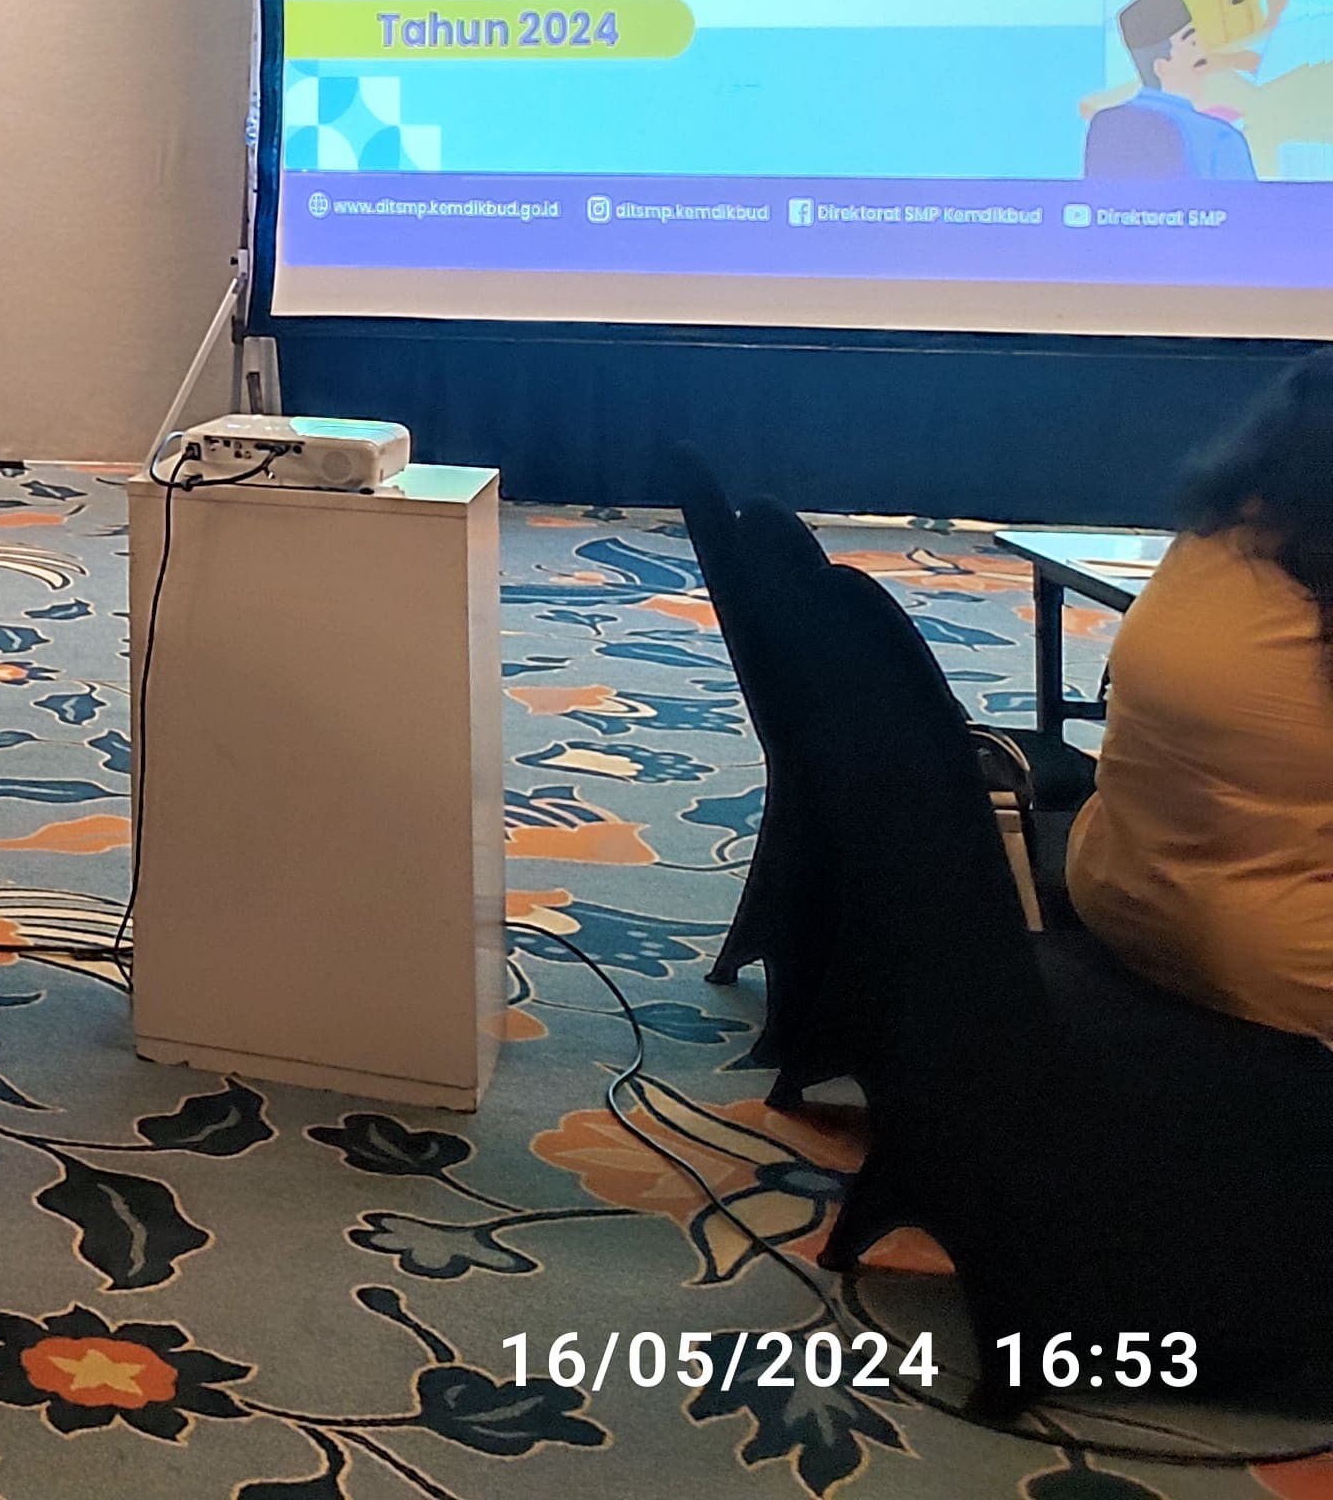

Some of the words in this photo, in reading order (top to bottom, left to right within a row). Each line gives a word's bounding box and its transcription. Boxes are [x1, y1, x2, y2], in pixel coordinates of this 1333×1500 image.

[376, 11, 510, 49] Tahun
[518, 10, 620, 48] 2024
[333, 199, 560, 223] www.ditsmp.kemdikbud.go.id
[615, 202, 771, 224] ditsmp.kemdikbud
[817, 203, 901, 222] Direktorat
[904, 206, 939, 223] SMP
[942, 206, 1043, 225] Kemdikbud
[1096, 208, 1184, 227] Direktorat
[1187, 210, 1228, 227] SMP
